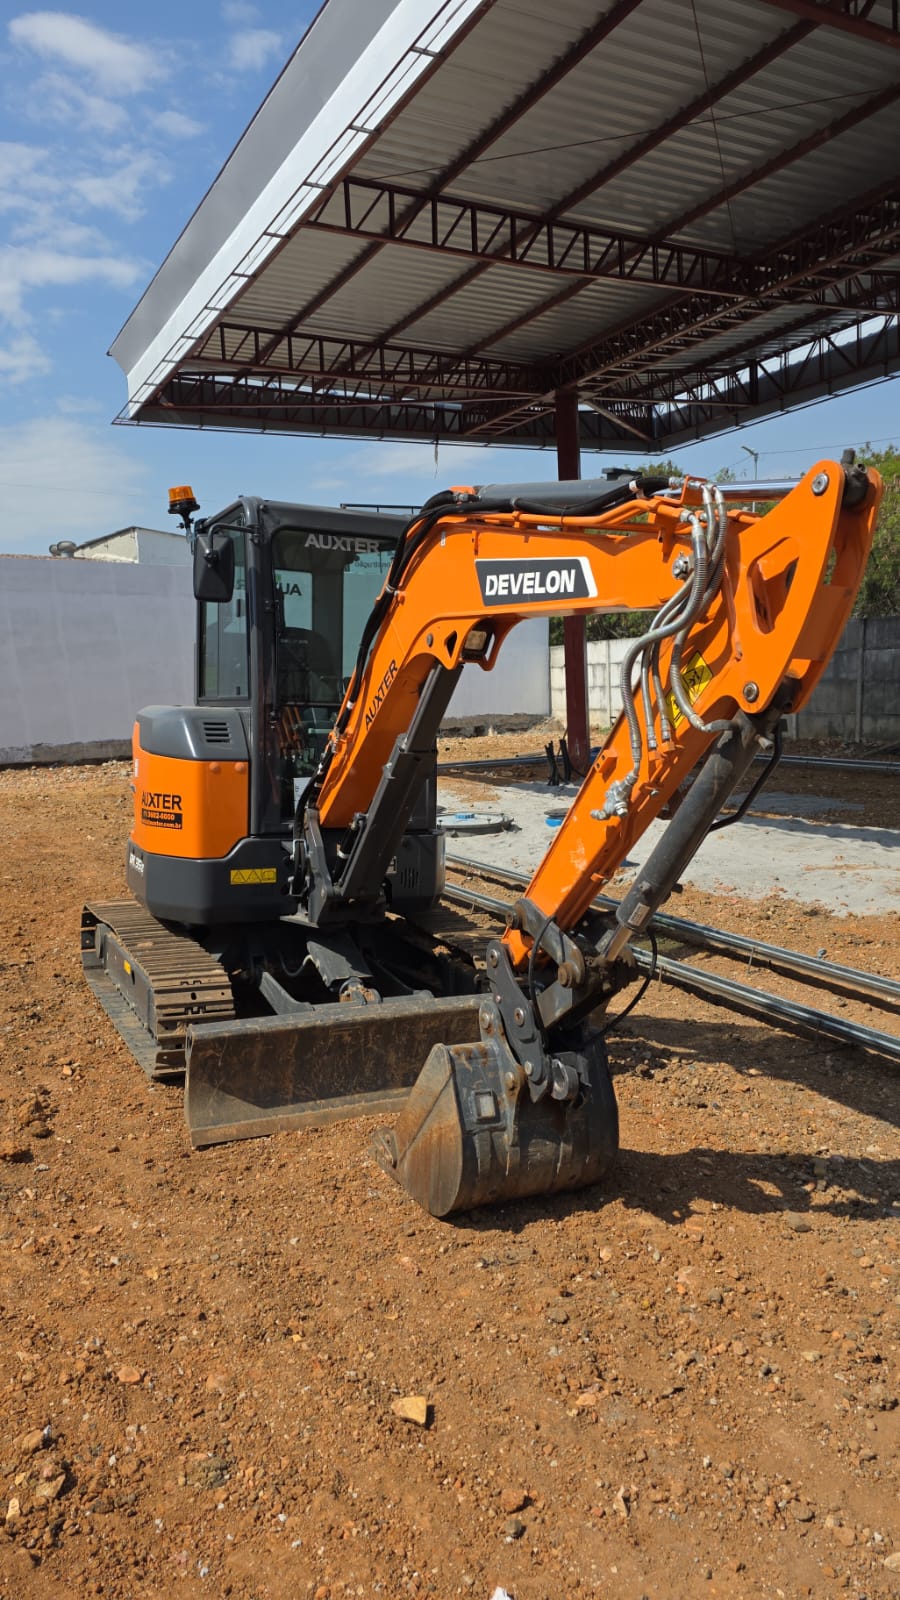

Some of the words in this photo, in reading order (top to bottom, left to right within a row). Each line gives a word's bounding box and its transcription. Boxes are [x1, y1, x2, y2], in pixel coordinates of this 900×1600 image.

[304, 533, 379, 553] AUXTER
[485, 569, 576, 596] DEVELON
[365, 659, 398, 730] AUXTER
[141, 792, 182, 811] AUXTER
